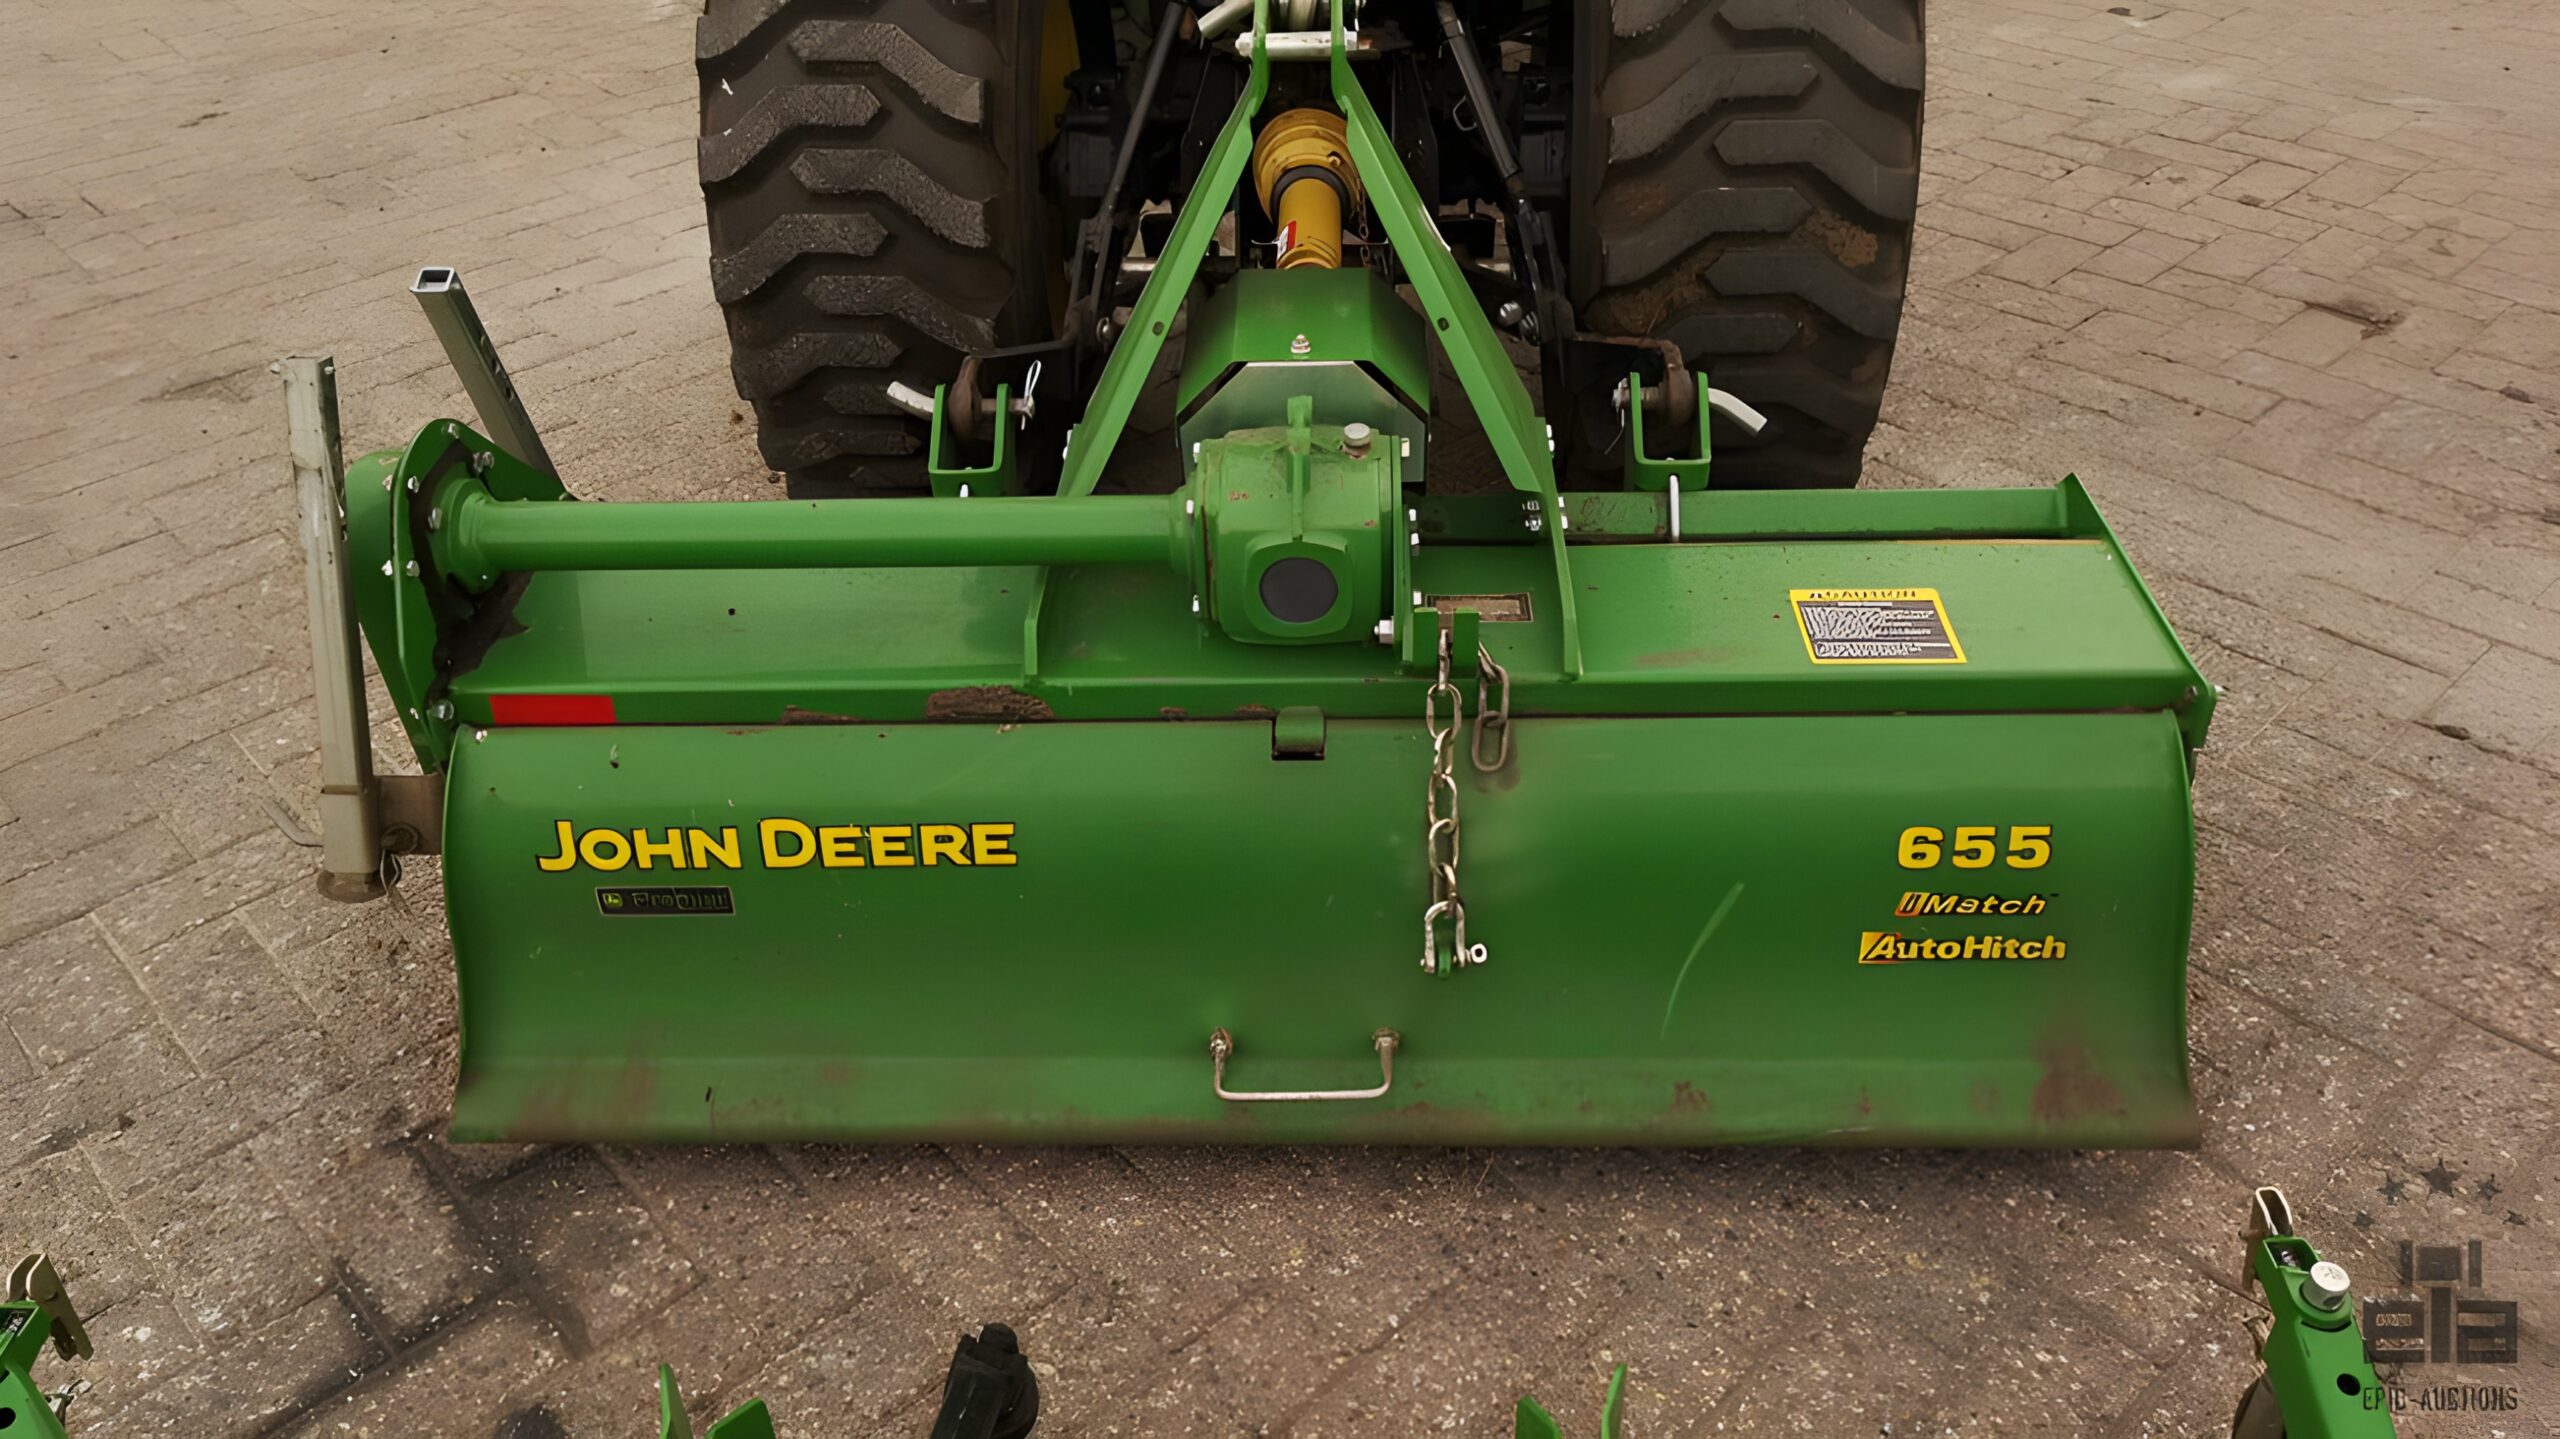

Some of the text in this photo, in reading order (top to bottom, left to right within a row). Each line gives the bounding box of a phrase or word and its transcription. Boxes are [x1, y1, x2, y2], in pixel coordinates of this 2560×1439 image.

[536, 817, 1018, 872] JOHN DEERE
[1897, 825, 2053, 870] 655
[1858, 931, 2068, 964] AutoHitch
